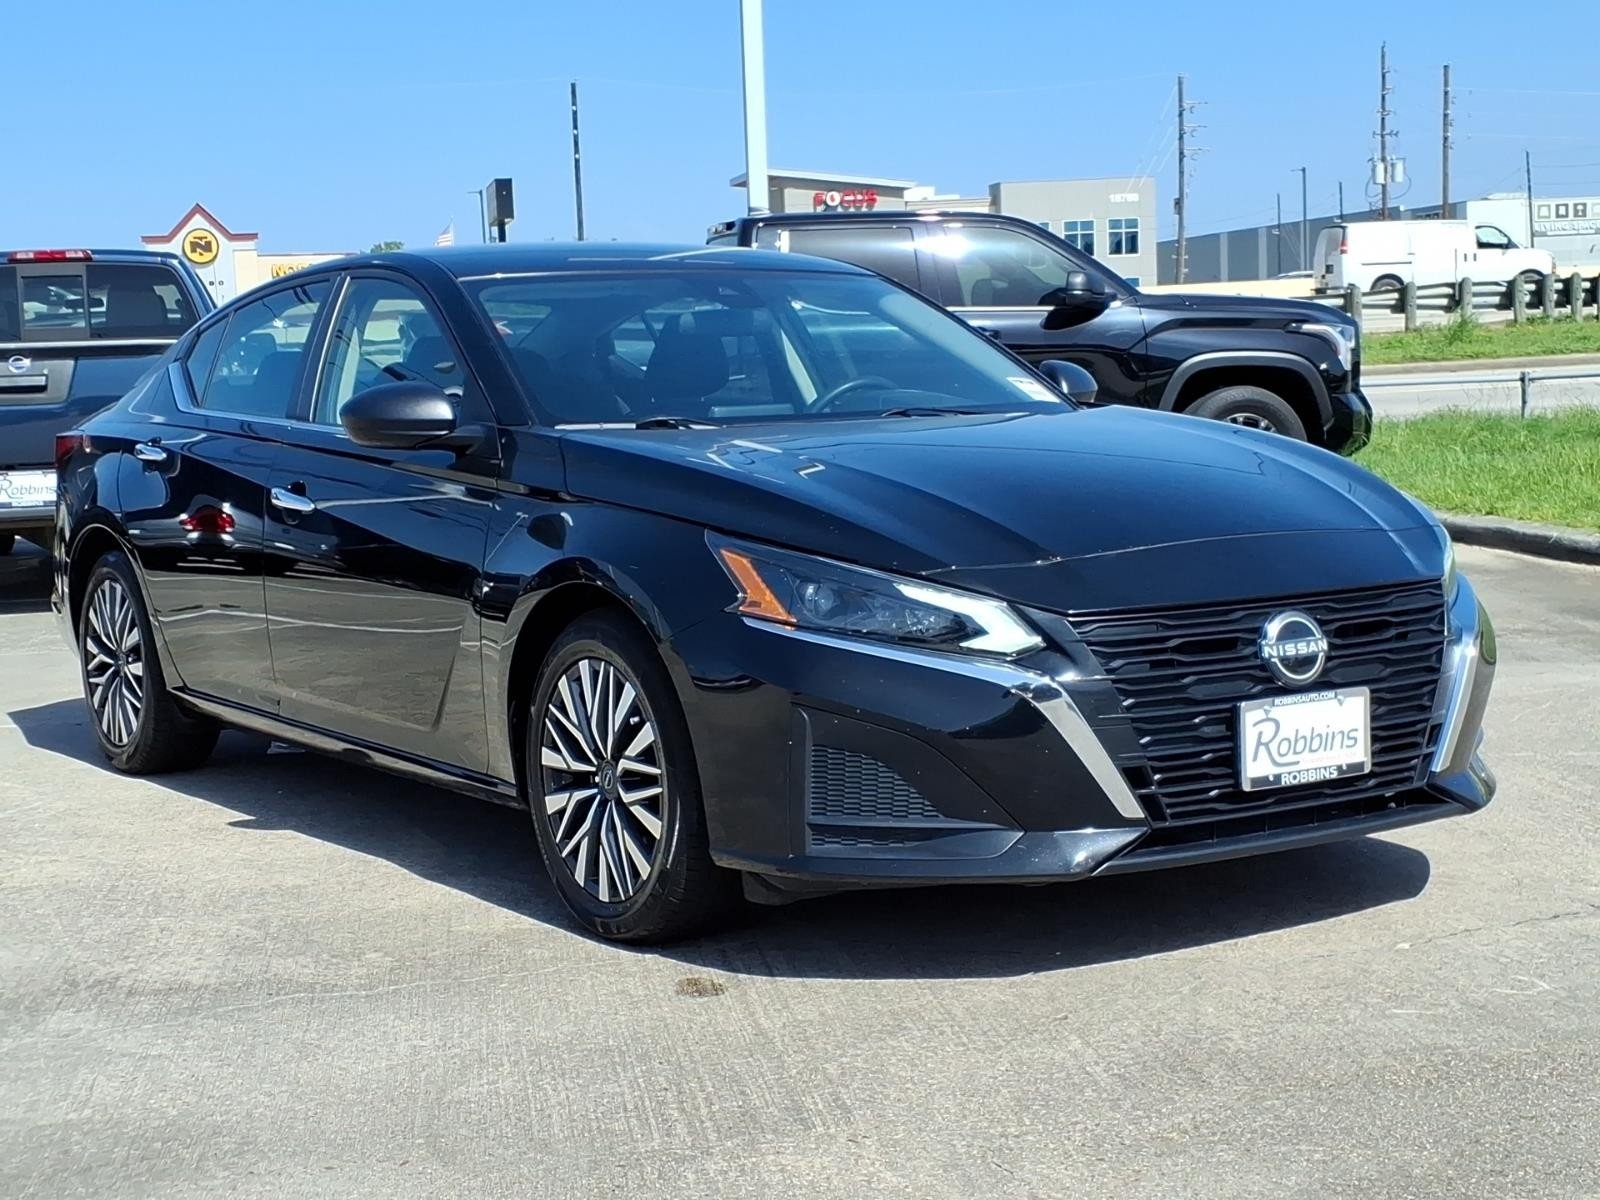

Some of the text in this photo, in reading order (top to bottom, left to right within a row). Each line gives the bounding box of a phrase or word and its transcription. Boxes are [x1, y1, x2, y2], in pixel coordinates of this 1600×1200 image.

[813, 188, 878, 208] FOCUS
[1264, 639, 1328, 658] NISSAN
[1274, 692, 1336, 706] ROBBINSAUTO.COM
[1252, 717, 1359, 767] Robbins
[1281, 766, 1338, 785] ROBBINS
